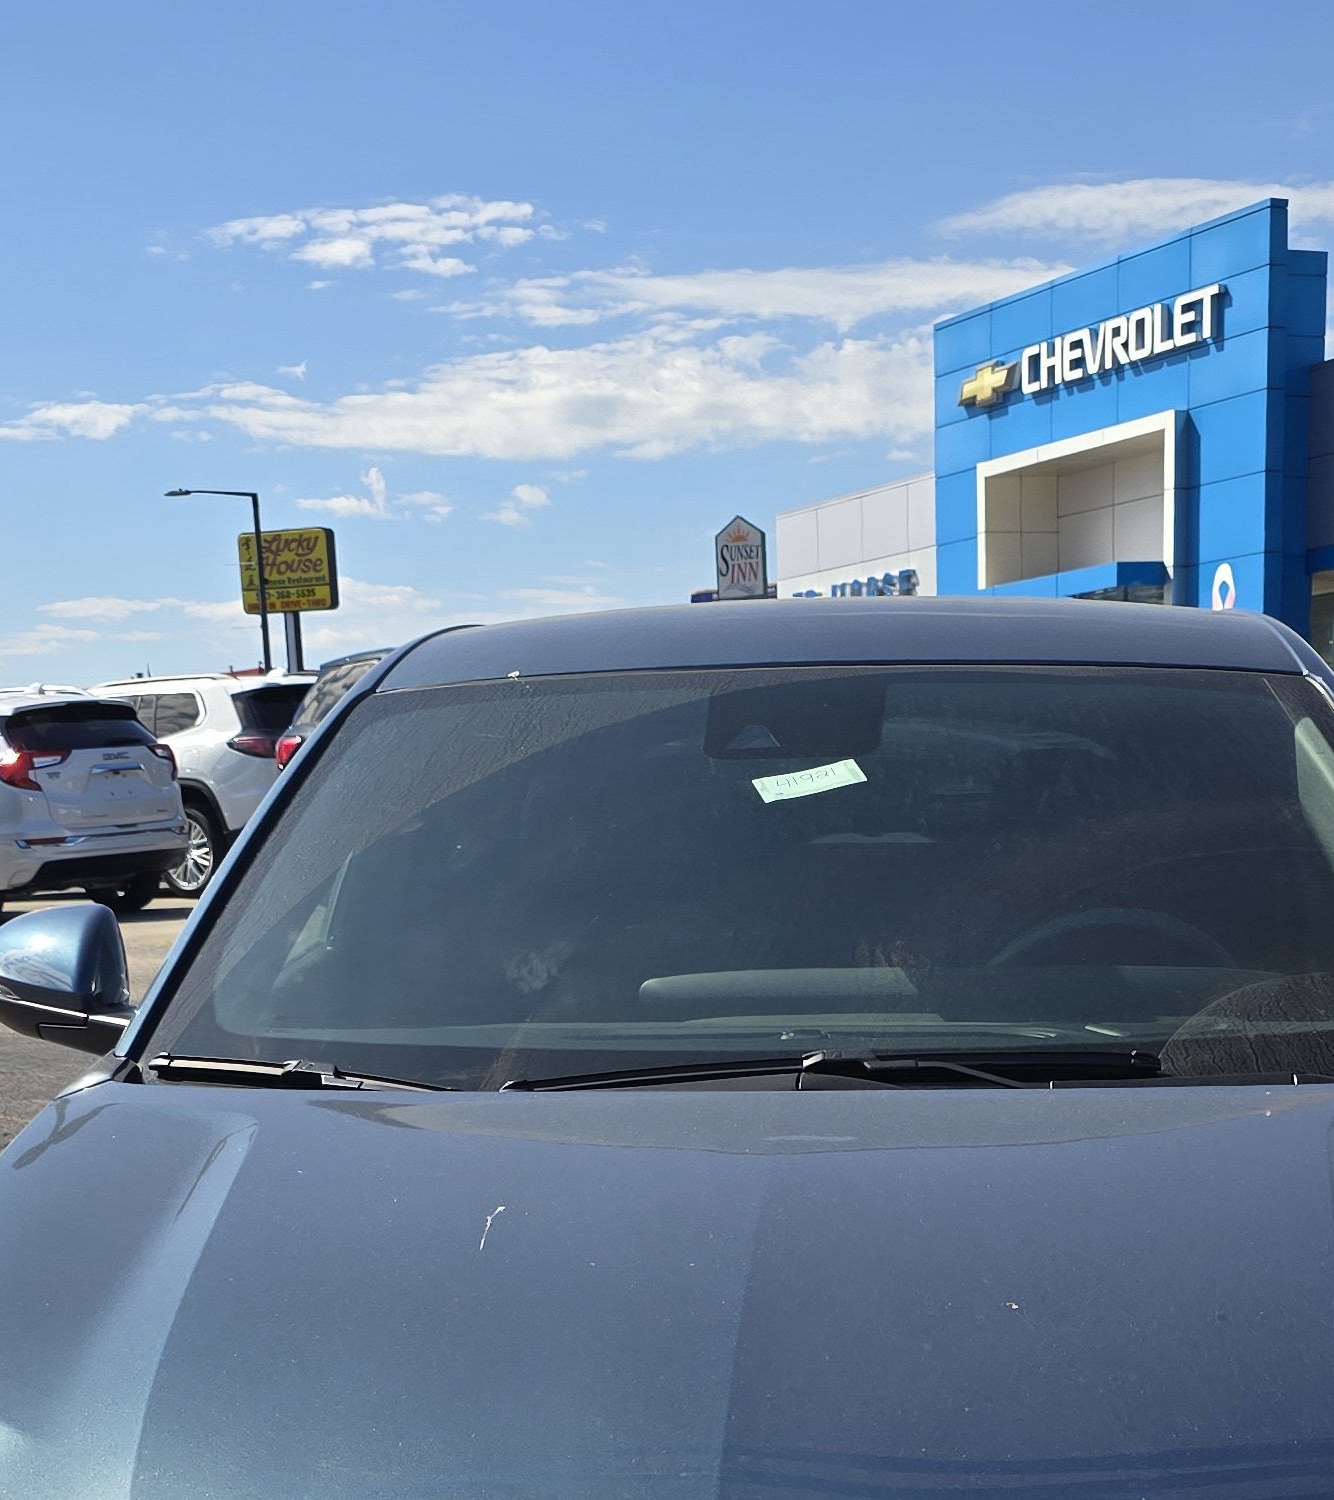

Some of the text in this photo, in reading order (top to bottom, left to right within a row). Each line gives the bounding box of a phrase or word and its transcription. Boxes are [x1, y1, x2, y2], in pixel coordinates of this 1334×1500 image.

[1021, 283, 1225, 395] CHEVROLET
[262, 533, 319, 557] Lucky
[263, 556, 324, 577] House
[720, 544, 761, 577] SUNSET
[731, 561, 759, 584] INN
